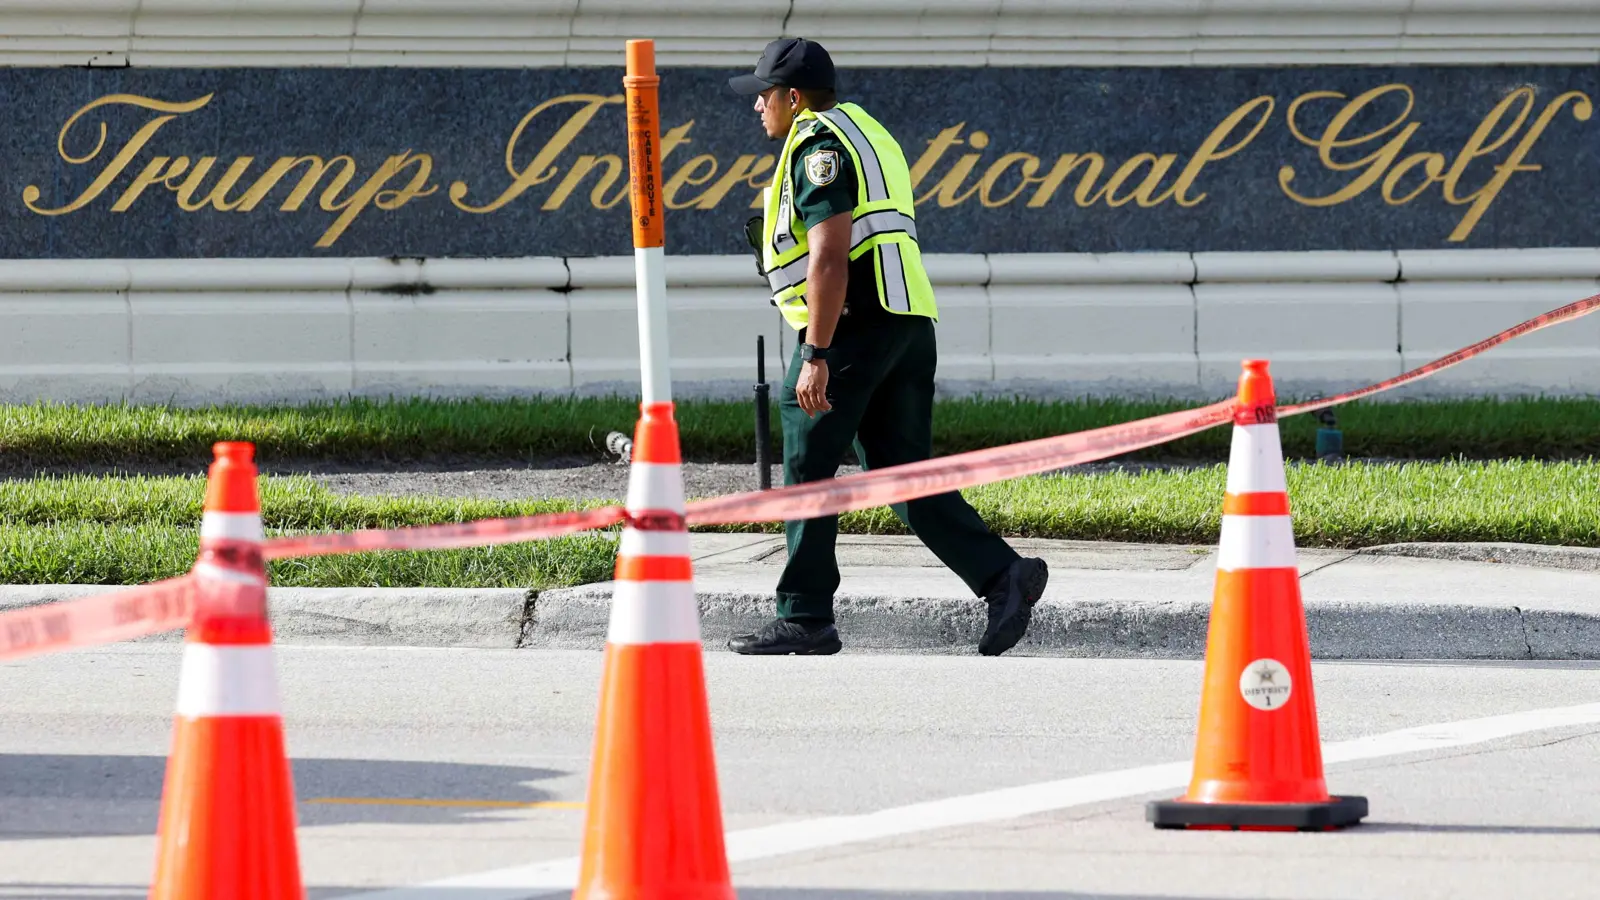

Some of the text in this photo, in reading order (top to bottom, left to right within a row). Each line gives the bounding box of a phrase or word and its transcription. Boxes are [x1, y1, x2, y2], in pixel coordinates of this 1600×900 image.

[22, 93, 438, 247] Trump
[1279, 83, 1592, 242] Golf
[645, 130, 656, 217] CABLE ROUTE
[1244, 686, 1289, 696] DISTRICT
[1265, 696, 1272, 706] 1
